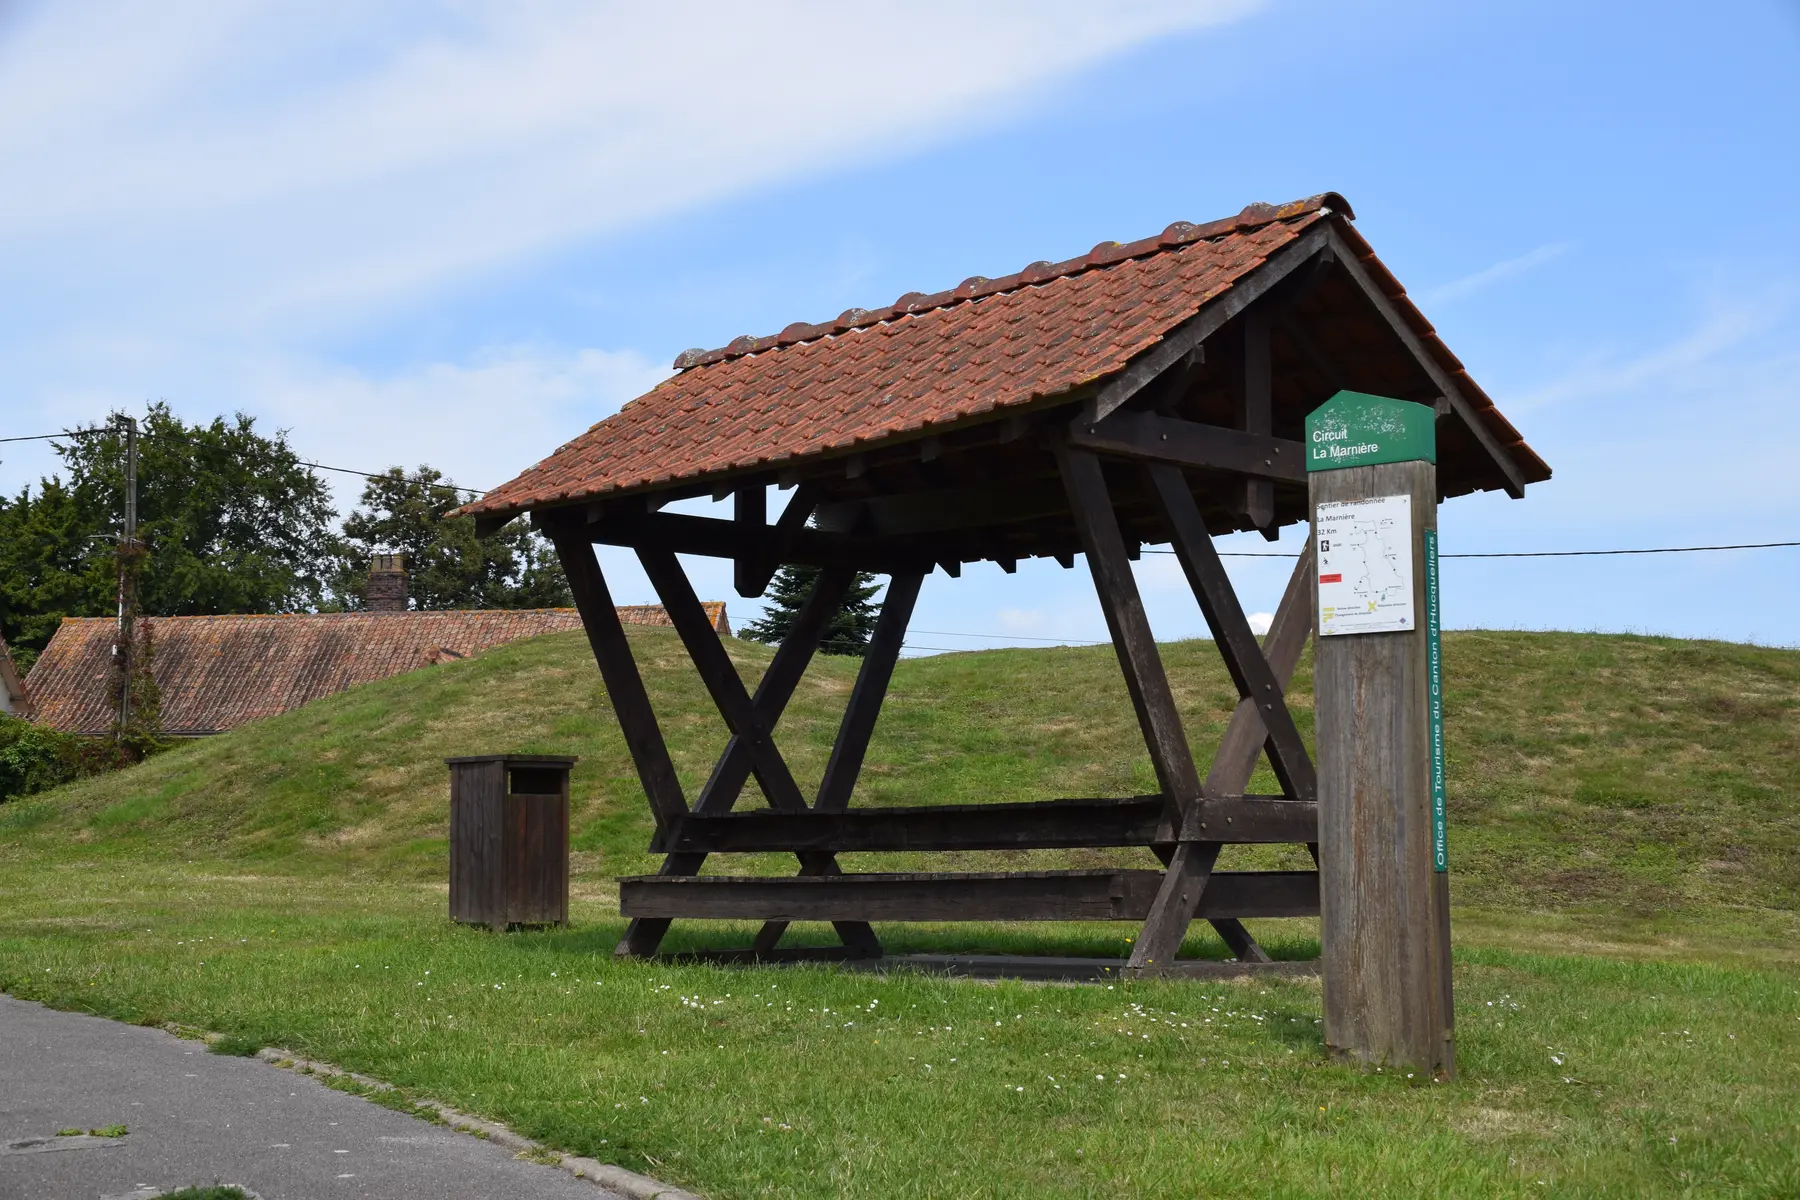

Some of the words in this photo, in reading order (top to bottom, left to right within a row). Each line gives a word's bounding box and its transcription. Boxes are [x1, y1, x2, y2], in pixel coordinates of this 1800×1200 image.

[1313, 428, 1347, 442] Circuit
[1313, 448, 1327, 460] La
[1330, 443, 1379, 457] Marnière
[1326, 514, 1355, 522] Marnière
[1429, 537, 1437, 636] d'Hucqueliers
[1433, 701, 1439, 718] du
[1436, 798, 1442, 815] de
